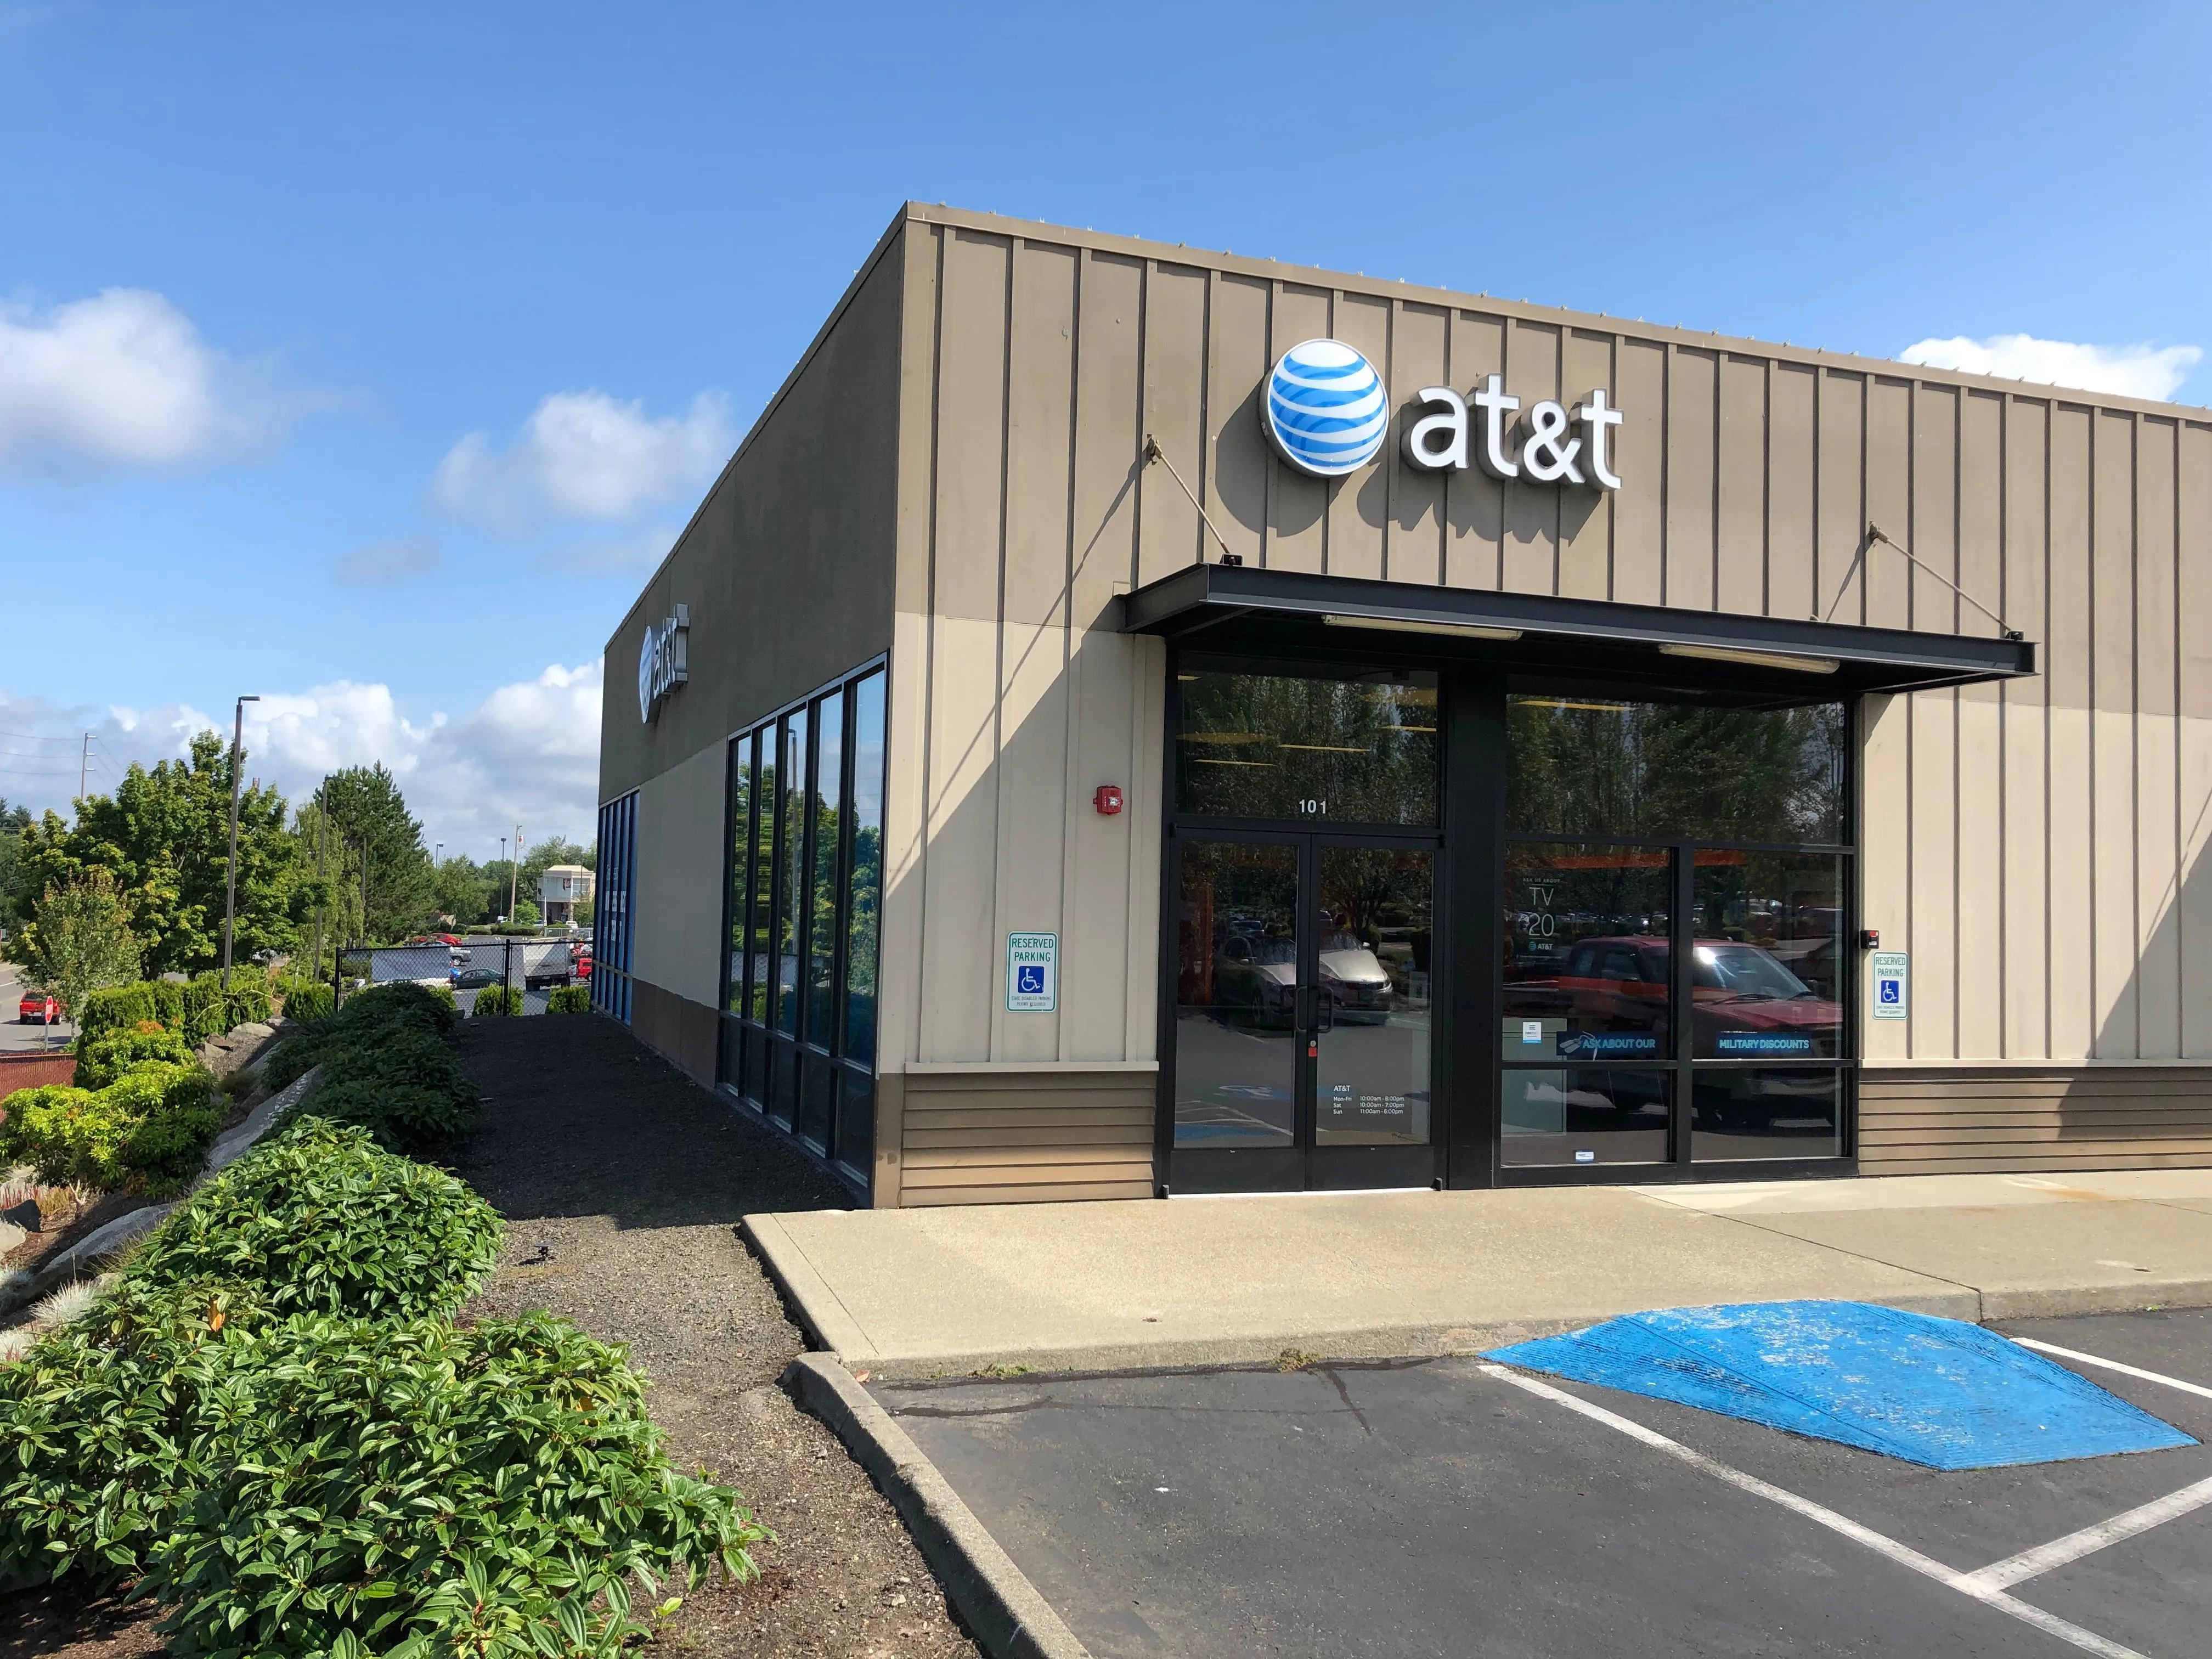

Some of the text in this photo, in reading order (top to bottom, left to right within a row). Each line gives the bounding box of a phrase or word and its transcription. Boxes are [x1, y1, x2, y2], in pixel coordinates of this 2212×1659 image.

[1409, 373, 1624, 489] at&t
[1299, 799, 1326, 814] 101
[1529, 887, 1554, 906] TV
[1529, 913, 1554, 936] 20
[1012, 938, 1054, 949] RESERVED
[1014, 952, 1051, 962] PARKING
[1875, 956, 1906, 966] RESERVED
[1877, 968, 1904, 977] PARKING
[1582, 1039, 1656, 1048] ASK ABOUT OUR
[1719, 1039, 1809, 1049] MILITARY DISCOUNTS
